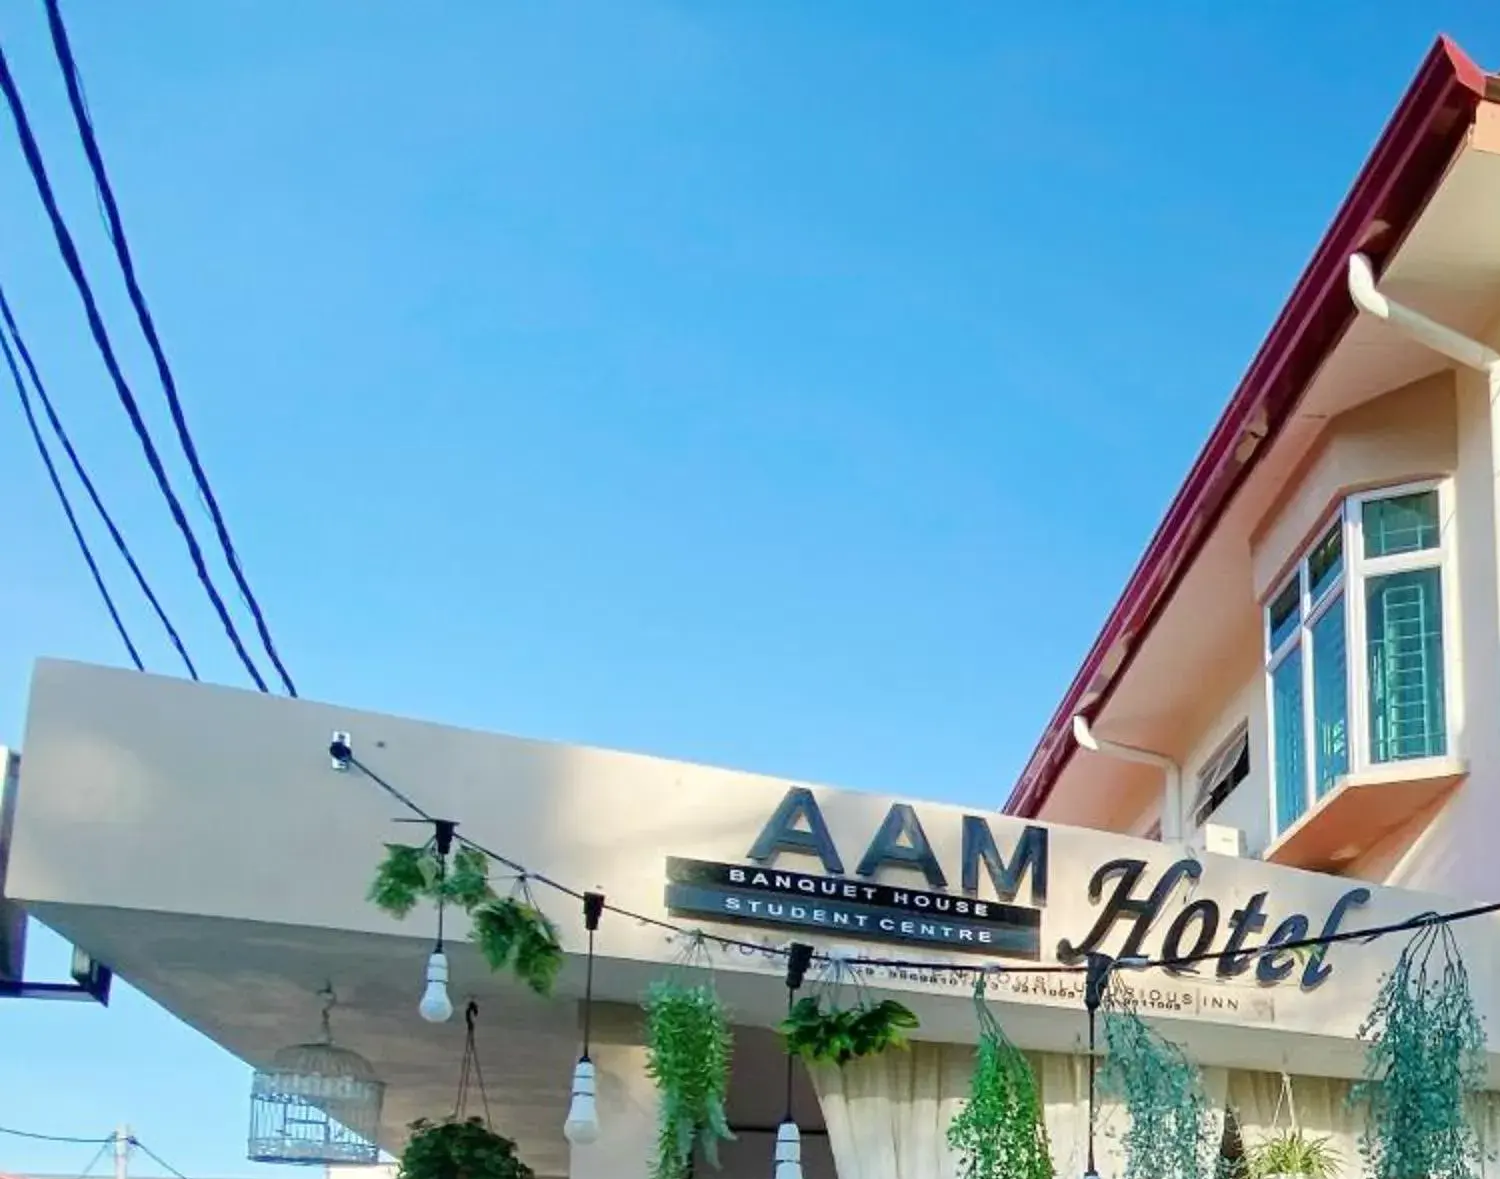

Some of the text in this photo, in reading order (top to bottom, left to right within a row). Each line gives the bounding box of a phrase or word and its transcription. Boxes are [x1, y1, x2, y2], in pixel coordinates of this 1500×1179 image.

[746, 785, 1050, 908] AAM
[728, 868, 990, 917] BANQUET HOUSE
[724, 897, 993, 943] STUDENT CENTRE
[1056, 858, 1371, 991] Hotel
[1059, 978, 1193, 1005] LUURIOUS
[1202, 995, 1240, 1011] INN
